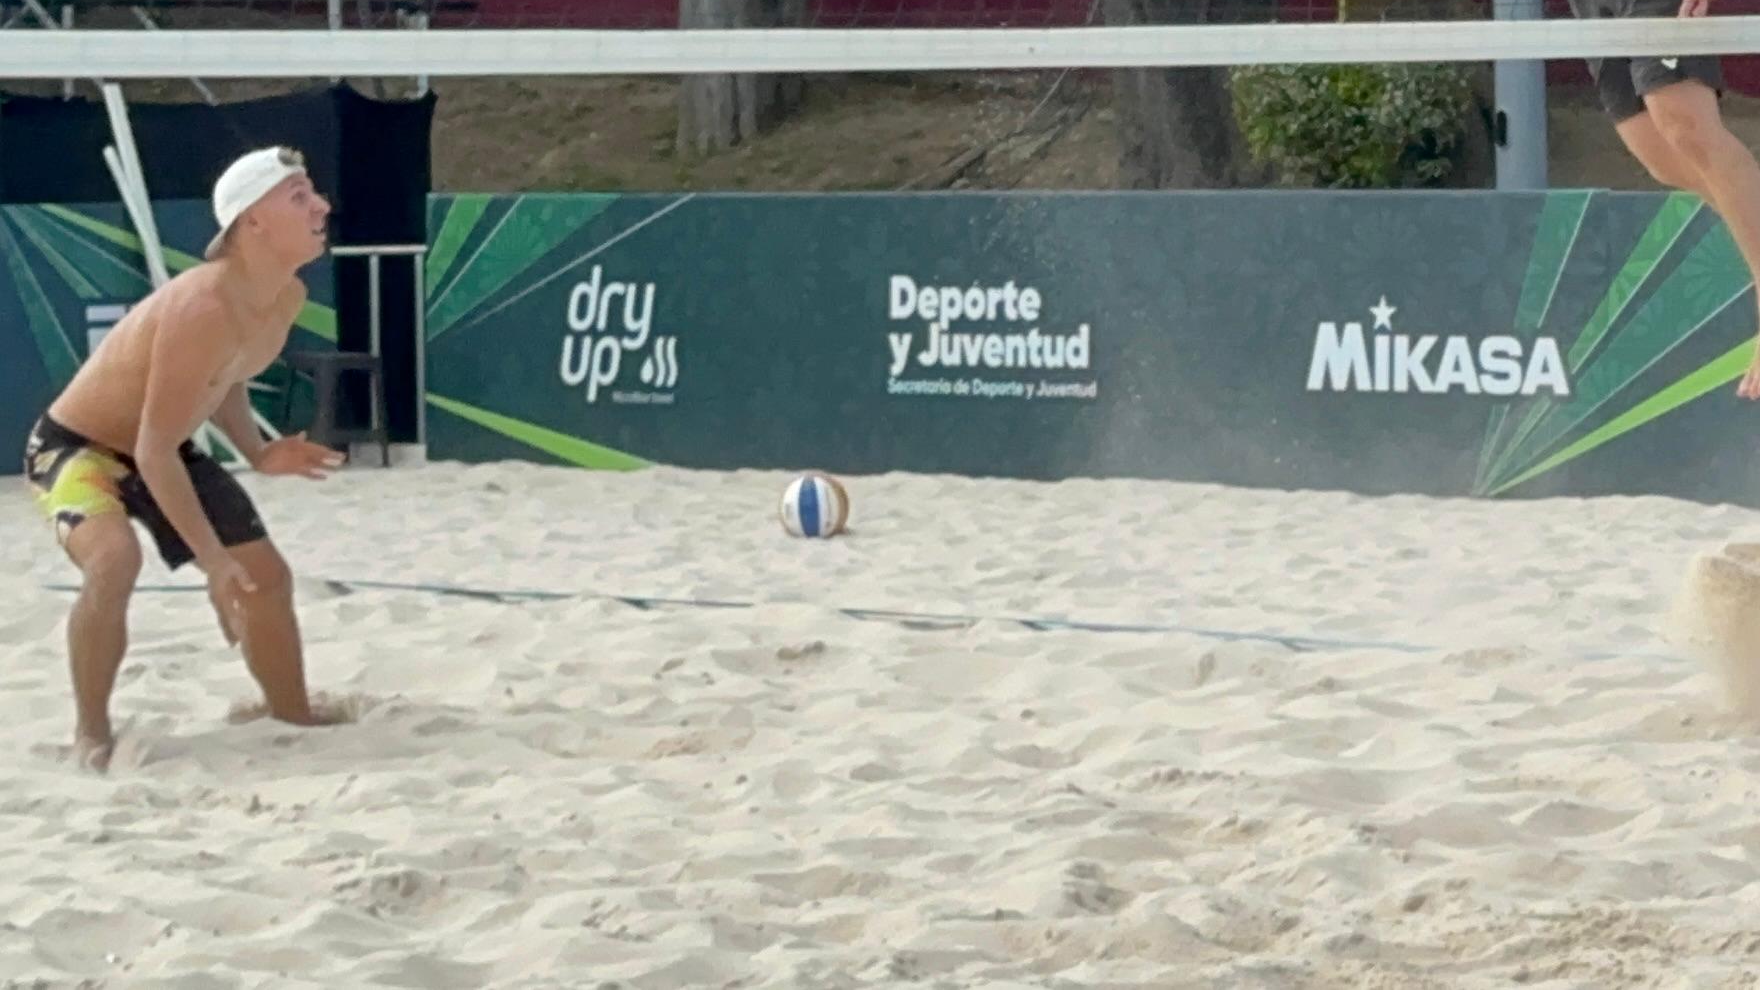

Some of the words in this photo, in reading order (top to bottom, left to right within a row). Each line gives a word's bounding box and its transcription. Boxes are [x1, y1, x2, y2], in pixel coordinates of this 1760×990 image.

[568, 264, 656, 350] dry
[889, 274, 1042, 330] Deporte
[561, 335, 621, 403] up
[888, 332, 912, 377] y
[917, 322, 1091, 369] Juventud
